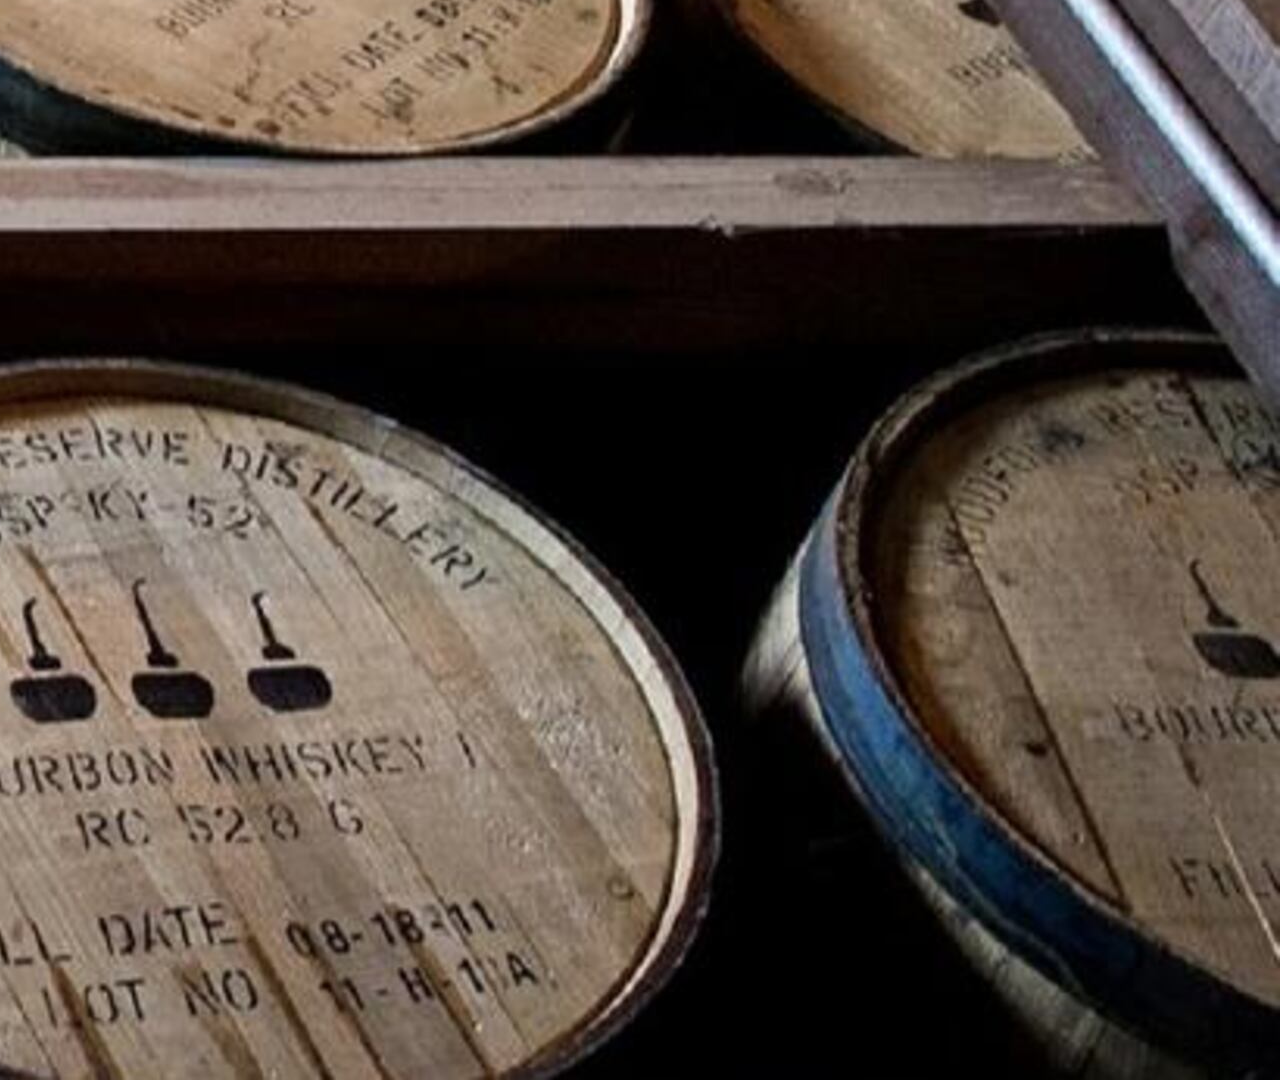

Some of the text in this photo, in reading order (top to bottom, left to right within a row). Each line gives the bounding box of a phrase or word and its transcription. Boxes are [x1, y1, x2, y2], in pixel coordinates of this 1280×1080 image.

[221, 437, 500, 592] DISTILLERY
[201, 732, 428, 786] WHISKEY
[76, 810, 151, 853] RC
[328, 799, 364, 836] G
[98, 900, 239, 959] DATE
[285, 898, 497, 961] 08-18-11
[182, 967, 260, 1019] NO
[319, 951, 539, 1015] 11-H-1A
